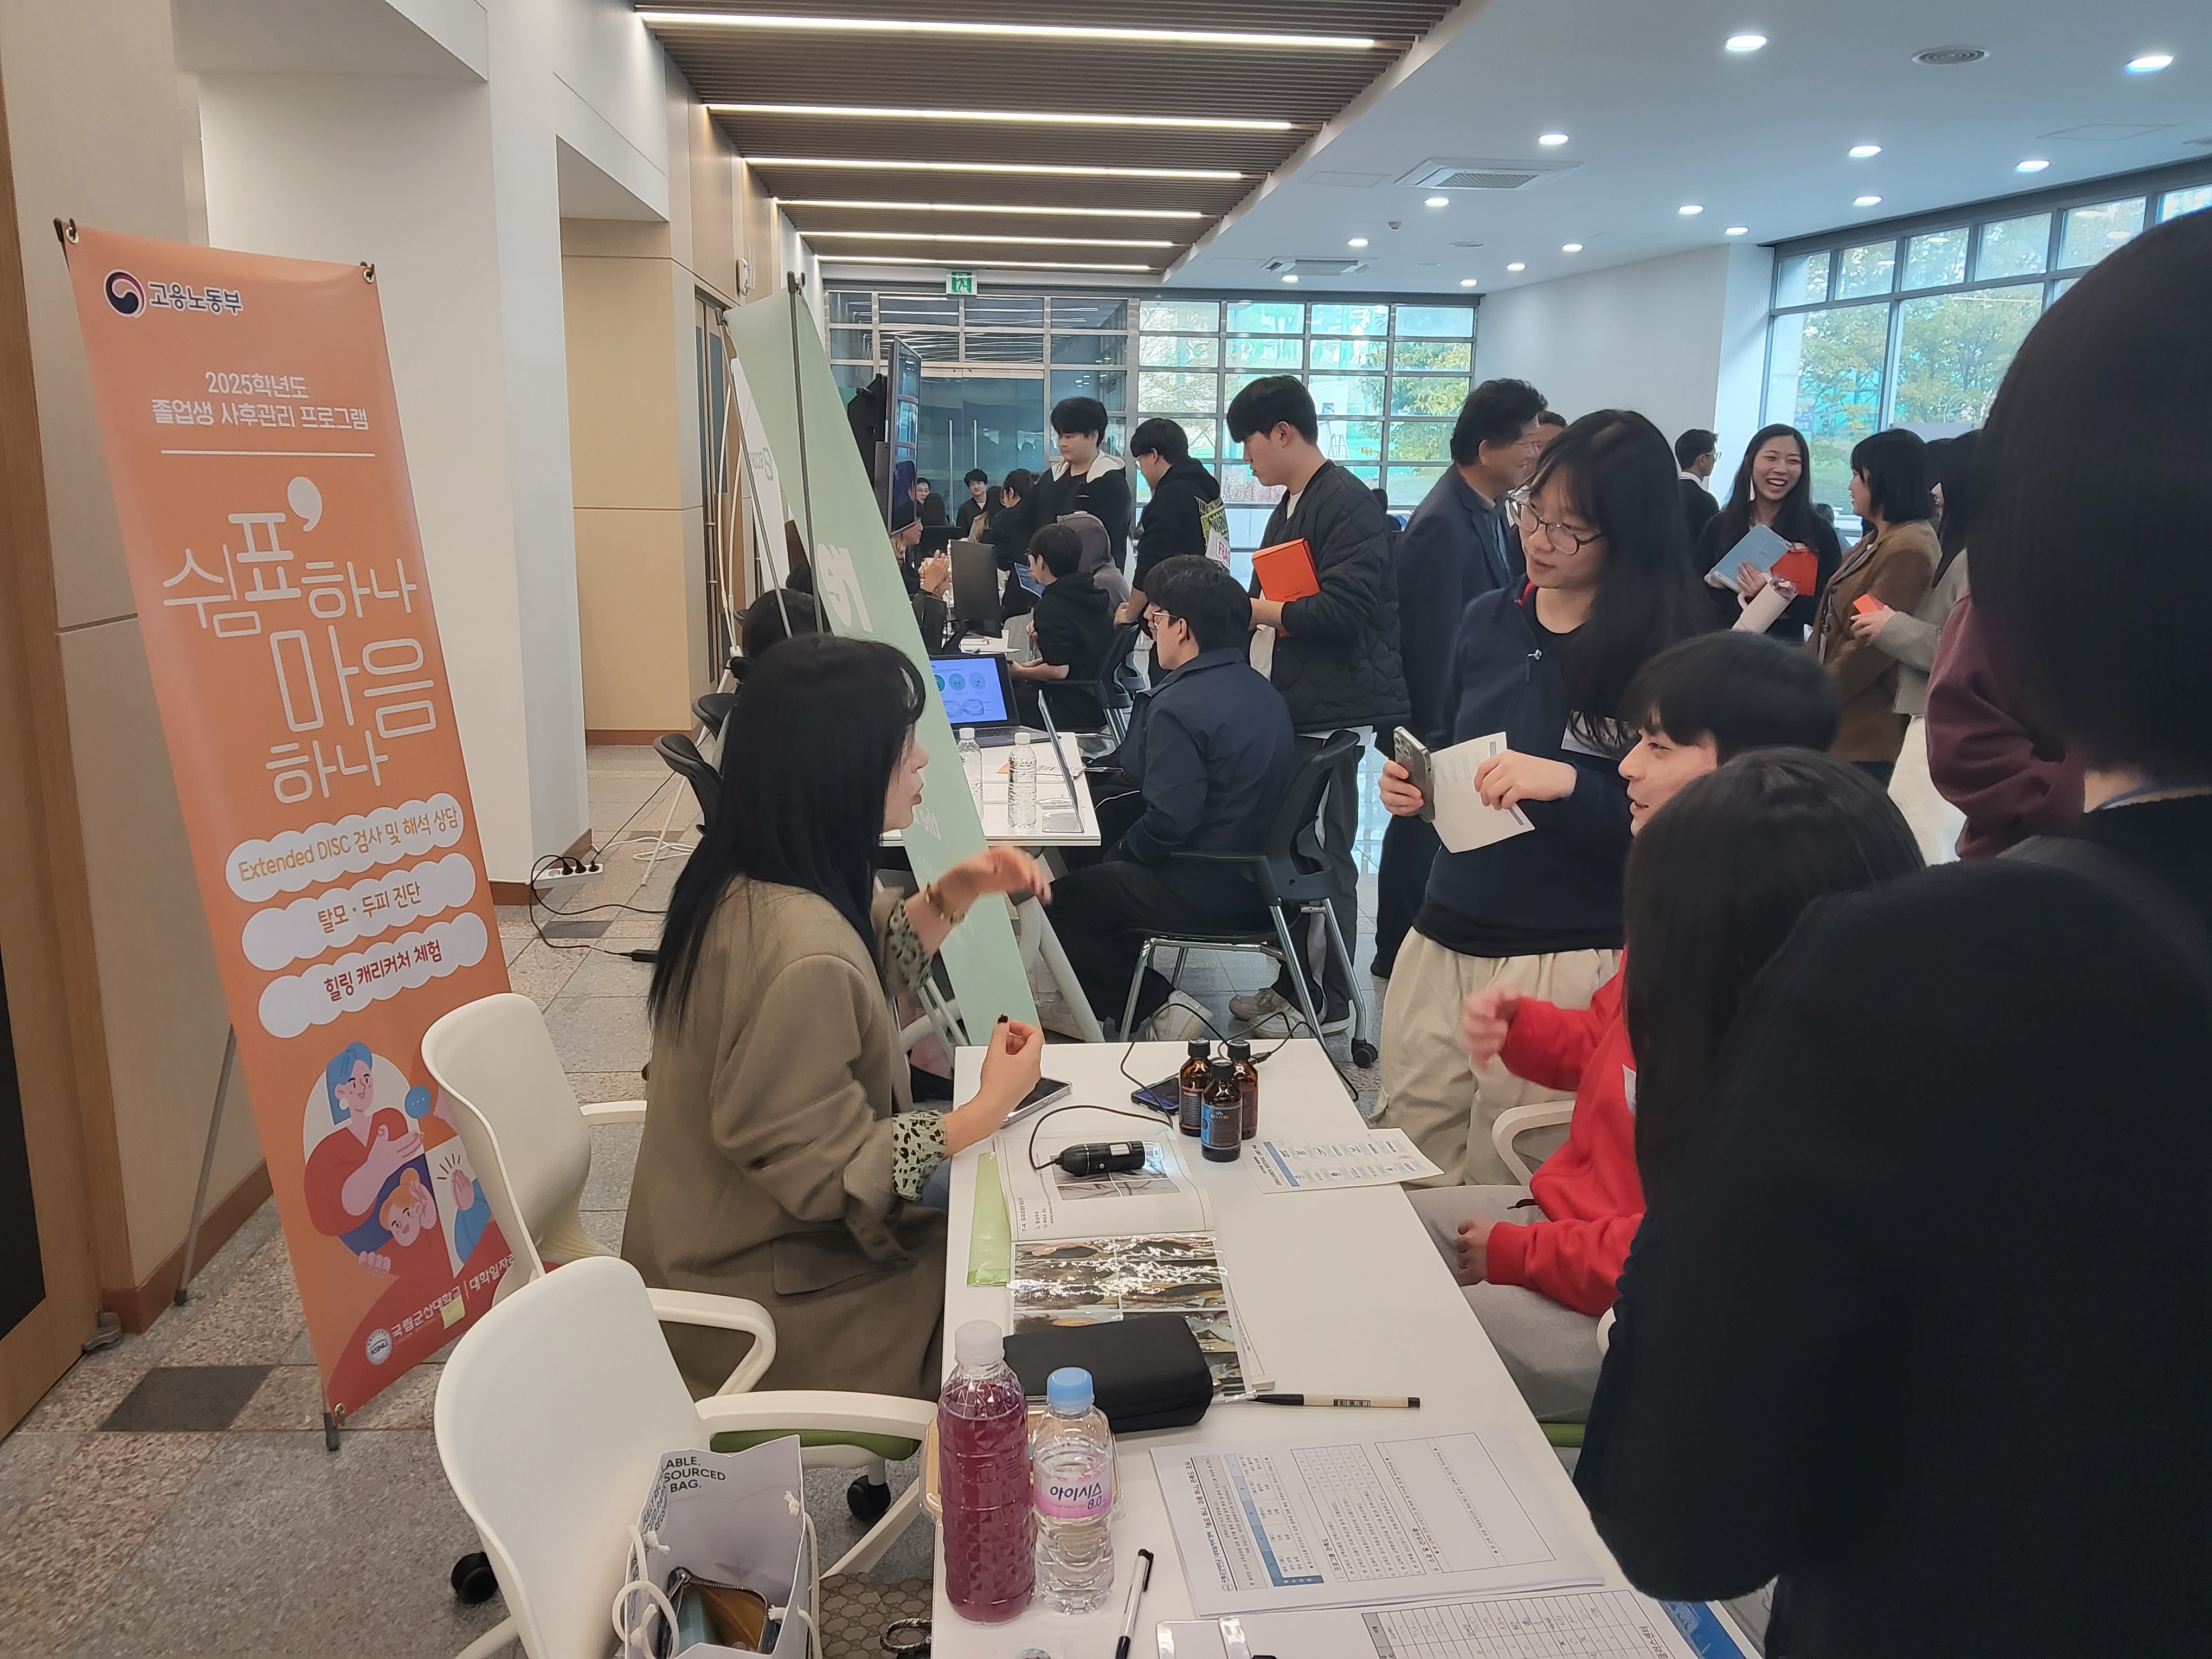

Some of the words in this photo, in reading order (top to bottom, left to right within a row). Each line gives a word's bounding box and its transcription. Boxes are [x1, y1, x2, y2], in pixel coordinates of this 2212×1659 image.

[149, 282, 242, 315] 고용노동부
[205, 371, 308, 399] 2025학년도
[152, 399, 214, 425] 졸업생
[221, 402, 295, 428] 사후관리
[300, 406, 369, 430] 프로그램
[270, 625, 436, 738] 마음
[266, 730, 388, 803] 하나
[238, 845, 315, 882] Extended
[317, 835, 351, 860] DISC
[353, 826, 382, 854] 검사
[385, 821, 401, 846] 및
[402, 813, 432, 836] 해석
[433, 806, 459, 833] 상담
[317, 904, 349, 934] 탈모
[361, 890, 390, 918] 두피
[392, 880, 421, 908] 진단
[324, 972, 354, 1002] 힐링
[355, 950, 411, 986] 캐리커처
[413, 939, 443, 963] 체험
[664, 1467, 726, 1483] SOURCED
[670, 1479, 702, 1493] BAG.
[1050, 1482, 1102, 1501] 아이시스
[1087, 1495, 1102, 1510] 8.0
